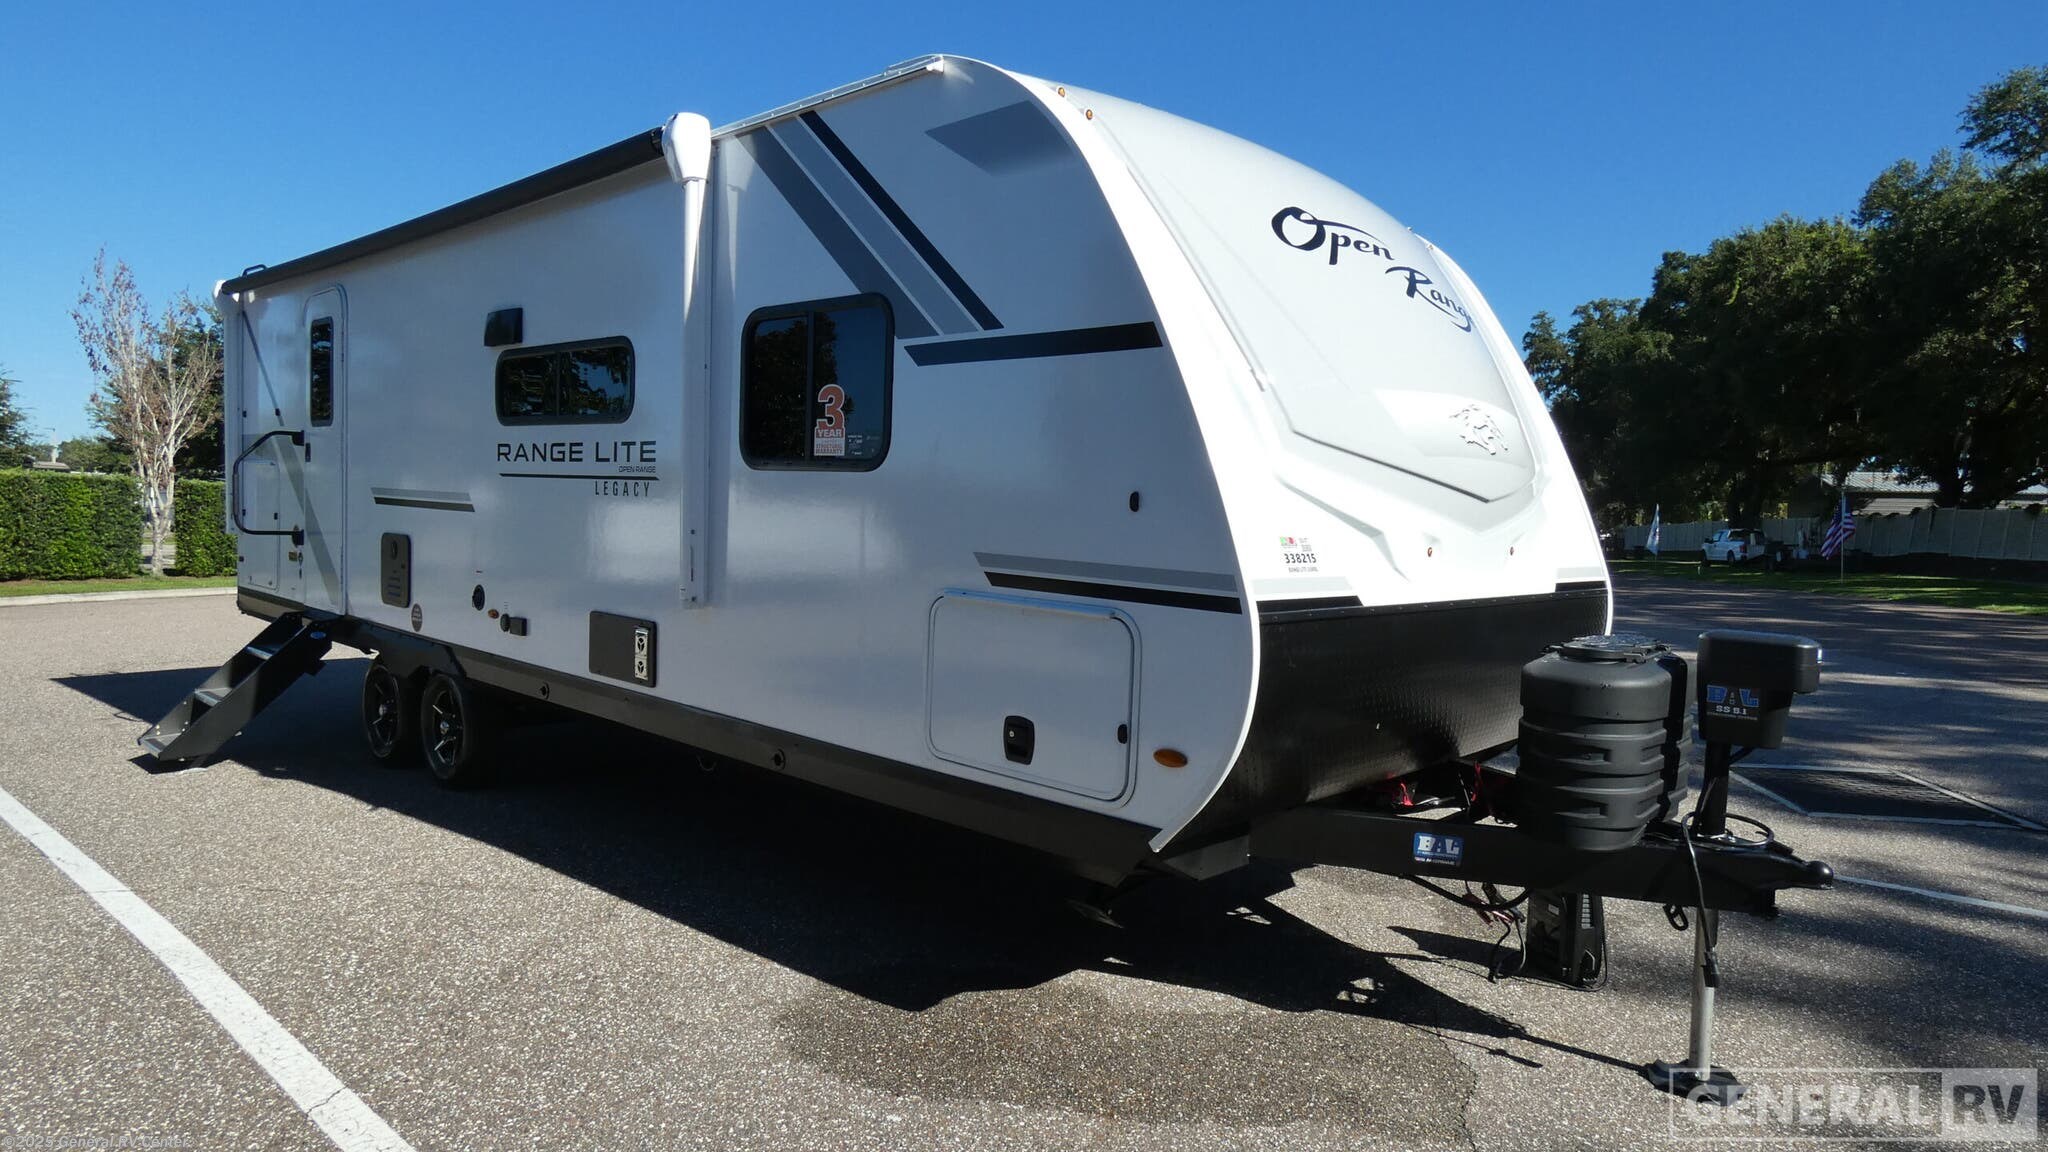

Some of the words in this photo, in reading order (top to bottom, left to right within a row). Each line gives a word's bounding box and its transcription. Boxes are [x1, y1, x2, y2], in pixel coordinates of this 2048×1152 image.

[1271, 206, 1395, 265] Open
[817, 384, 845, 430] 3
[817, 429, 842, 437] YEAR
[497, 442, 583, 462] RANGE
[595, 440, 657, 463] LITE
[635, 465, 656, 473] RANGE
[595, 480, 650, 497] LEGACY
[1284, 553, 1317, 564] 338215
